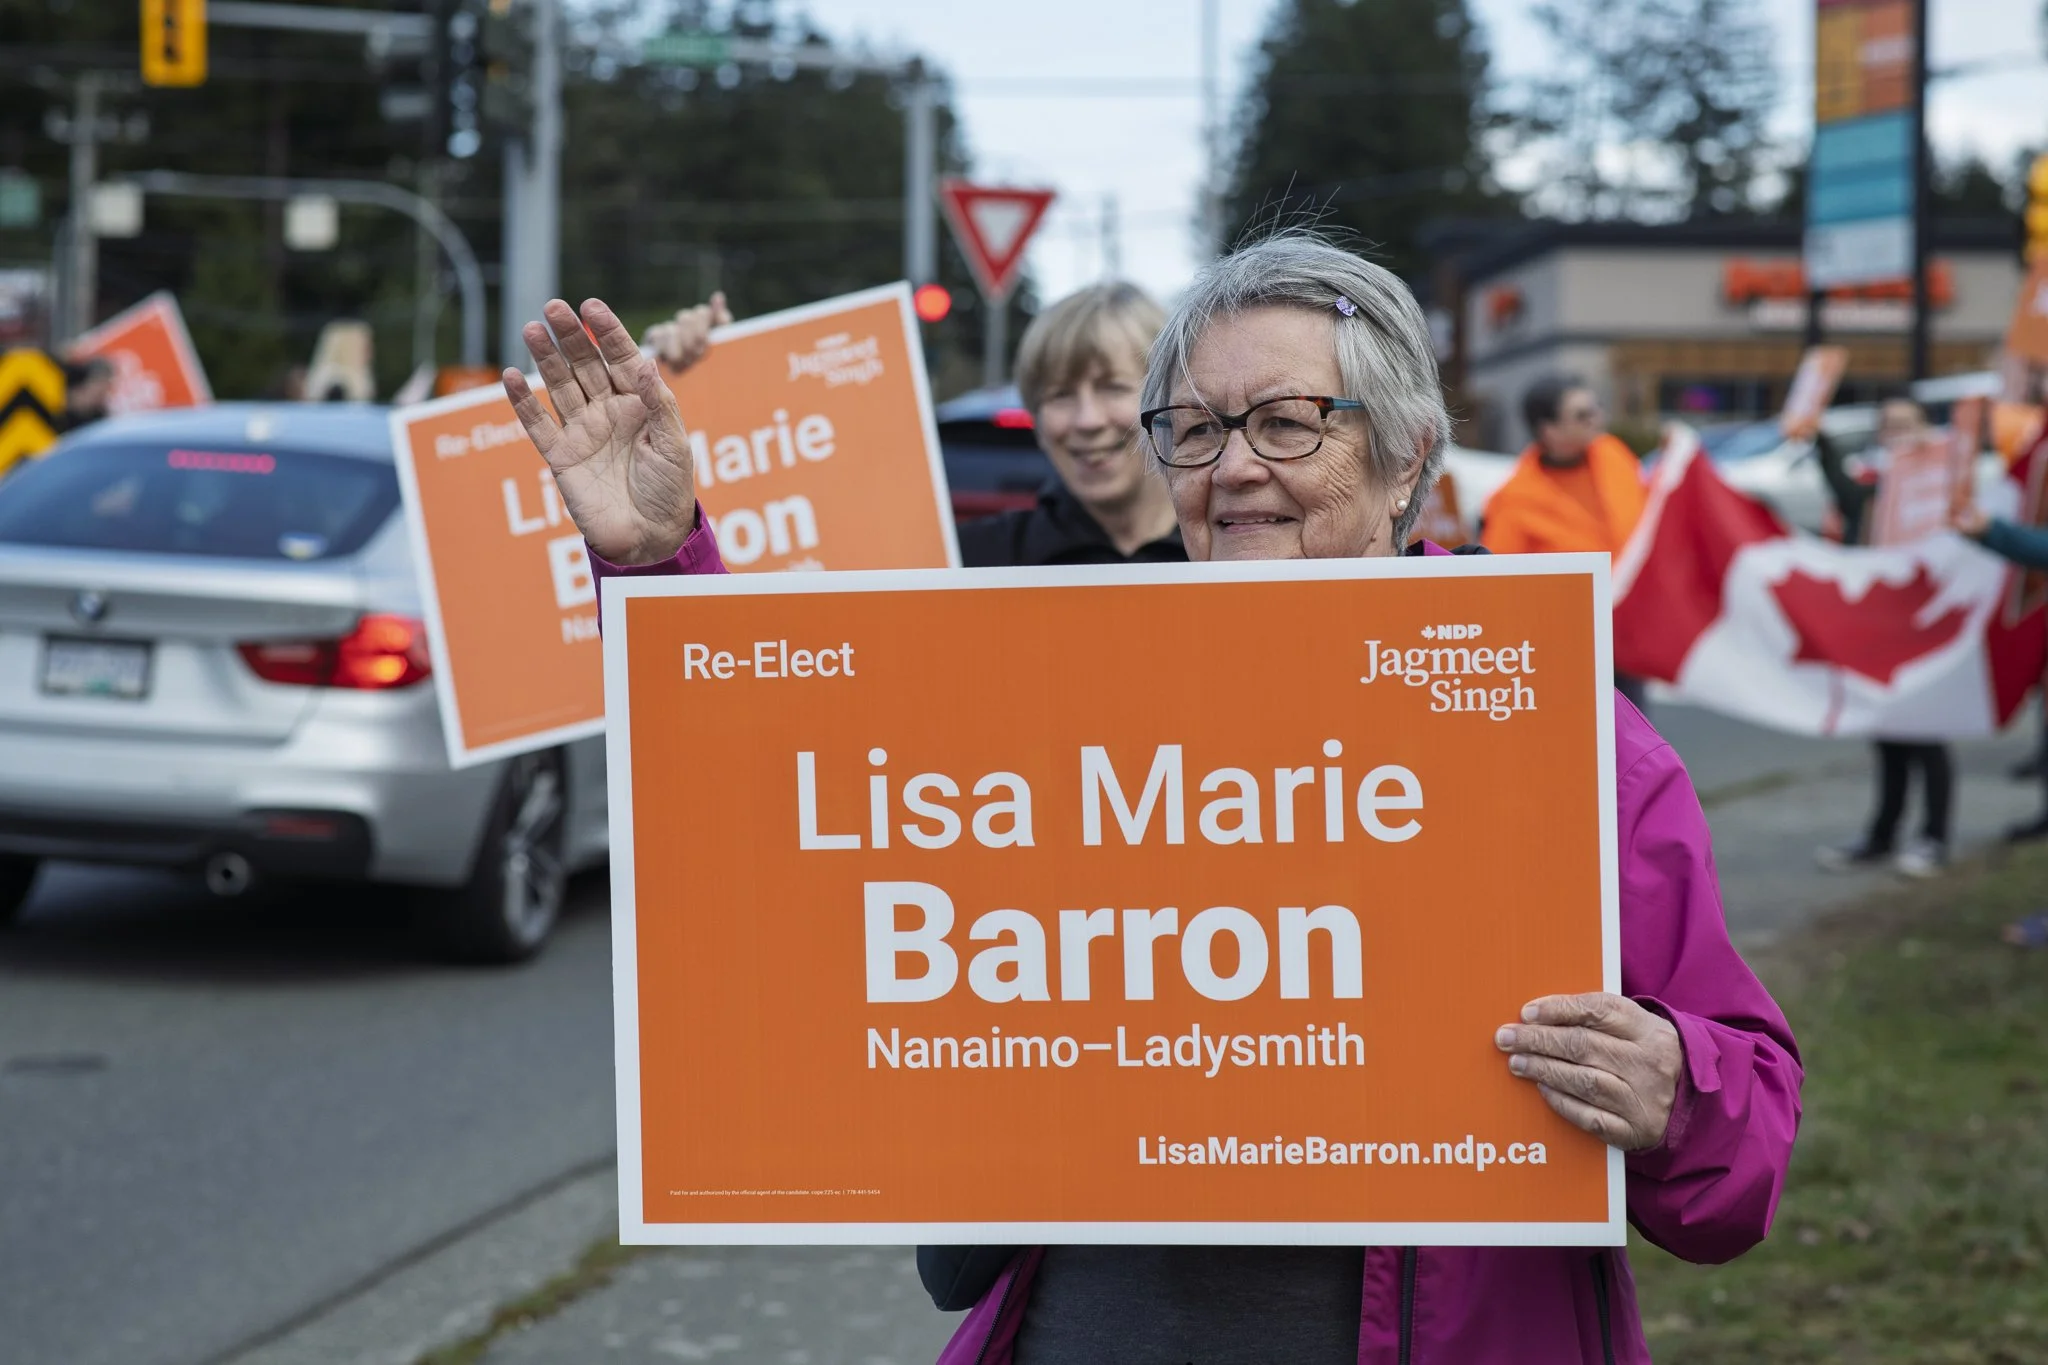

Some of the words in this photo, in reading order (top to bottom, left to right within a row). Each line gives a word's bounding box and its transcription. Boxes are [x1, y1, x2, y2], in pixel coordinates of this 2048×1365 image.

[1437, 624, 1483, 640] NDP
[683, 640, 855, 680] Re-Elect
[1360, 640, 1536, 687] Jagmeet
[1430, 677, 1537, 721] Singh
[797, 747, 1036, 851] Lisa
[1080, 739, 1424, 846] Marie
[863, 881, 1364, 1004] Barron
[1138, 1135, 1547, 1172] LisaMarieBarron.ndp.ca
